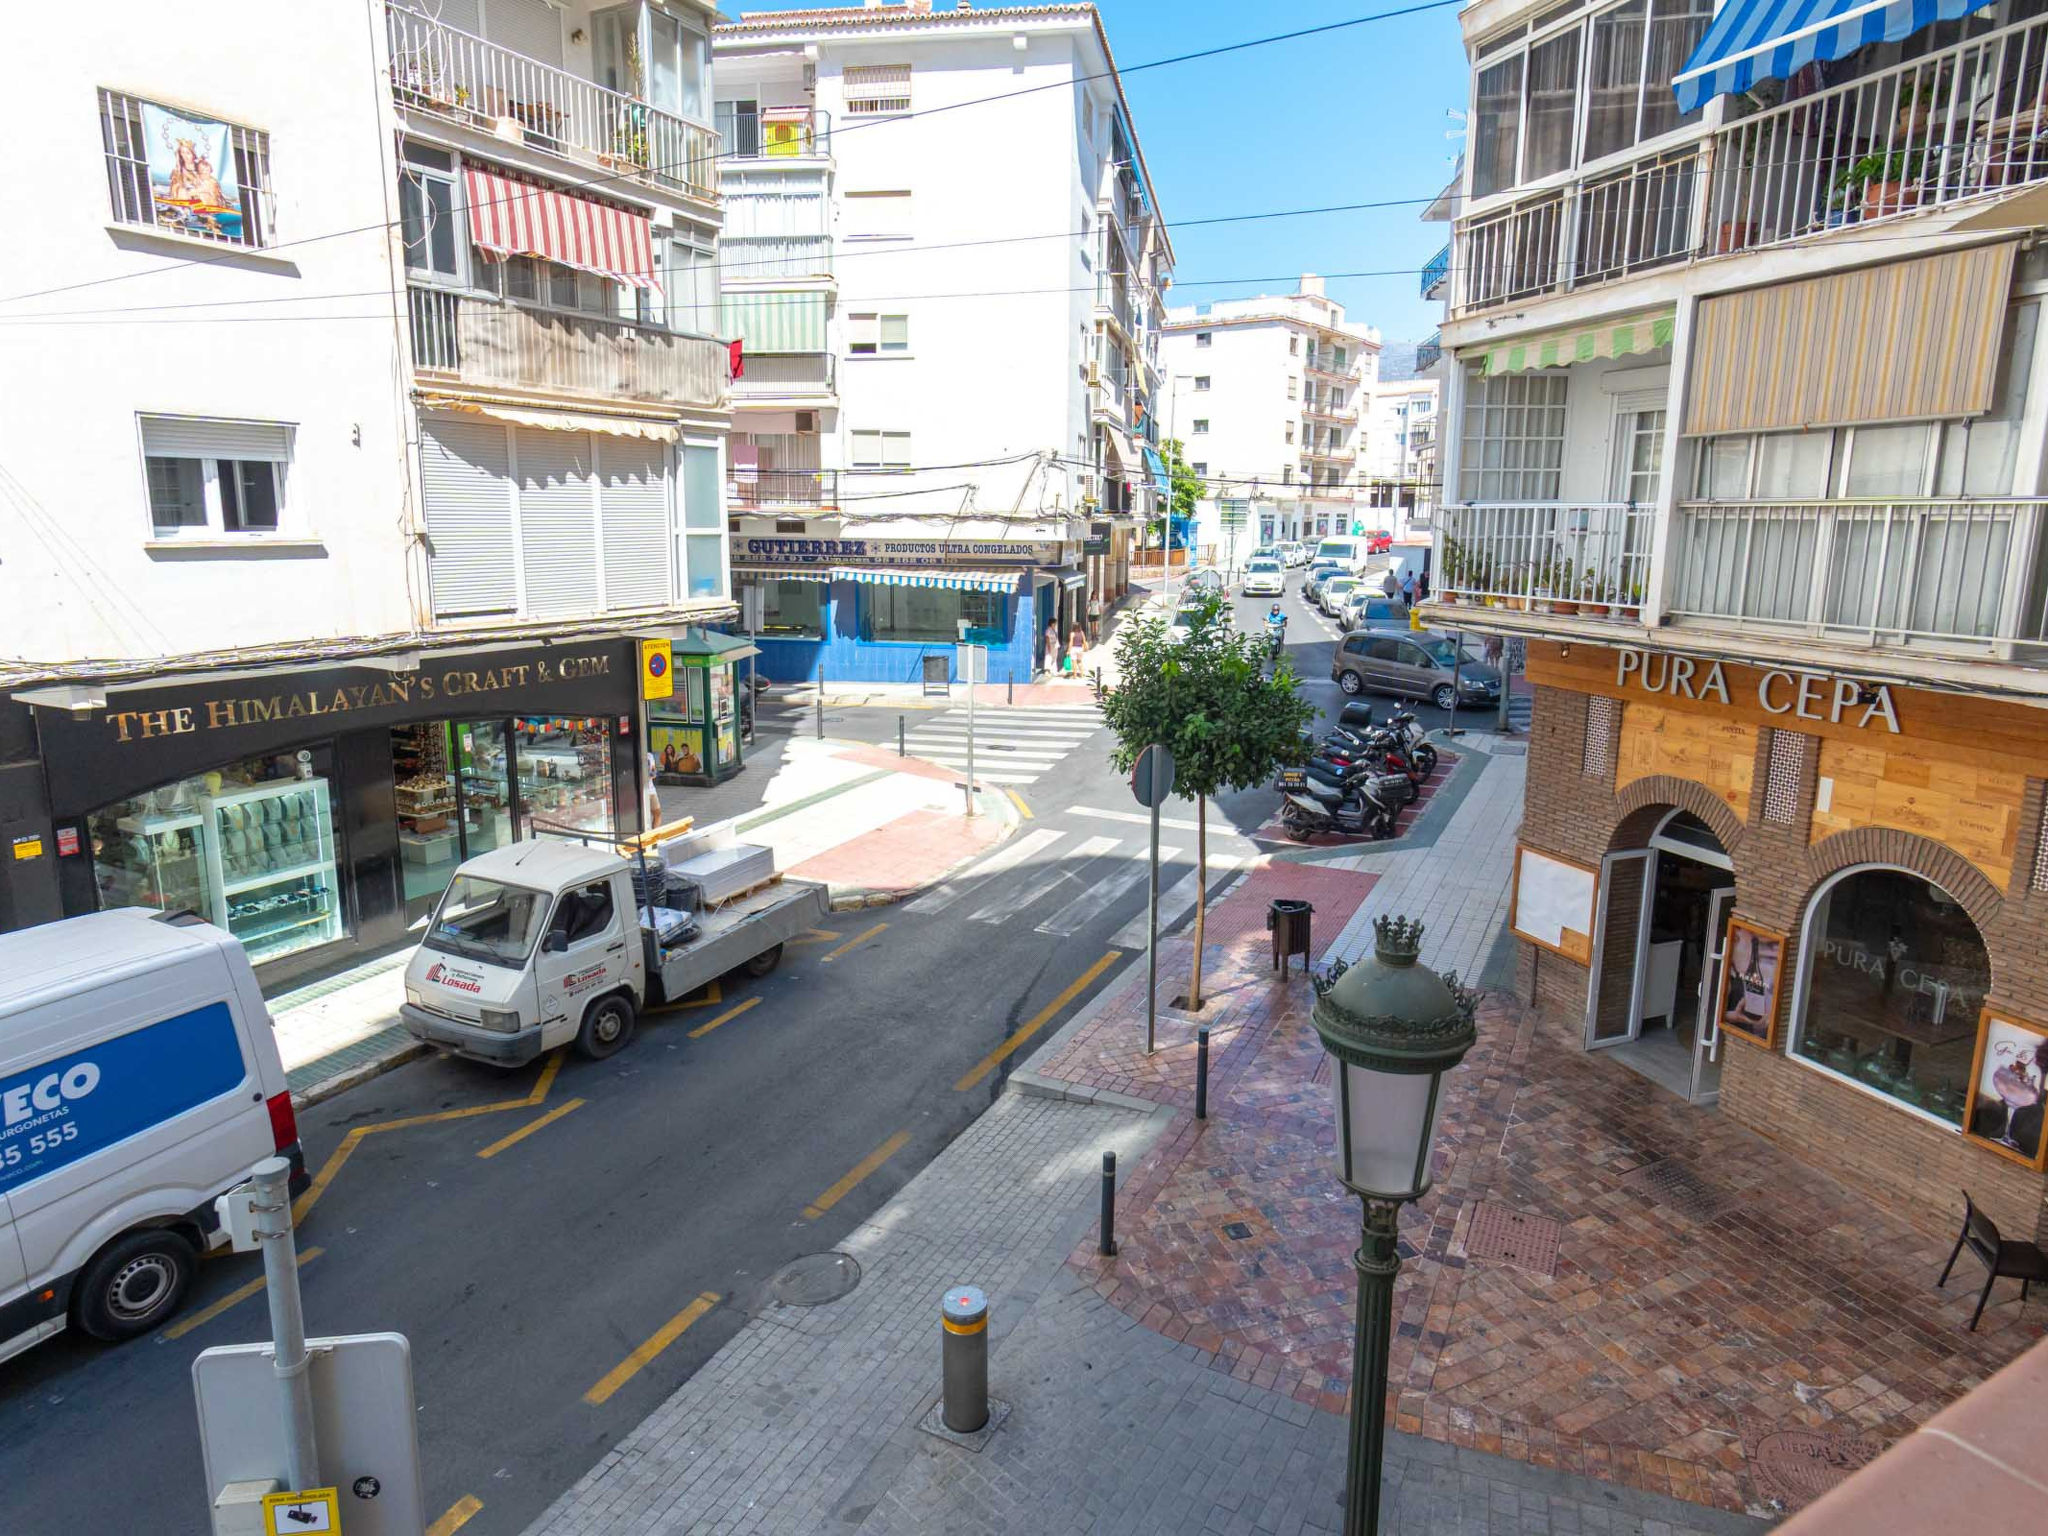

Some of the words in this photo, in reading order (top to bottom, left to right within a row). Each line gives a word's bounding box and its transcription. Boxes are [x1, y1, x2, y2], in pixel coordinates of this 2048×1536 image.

[747, 539, 868, 556] GUTIERREZ
[885, 543, 936, 553] PRODUCTOS
[939, 544, 970, 554] ULTRA
[973, 544, 1034, 555] CONGELADOS
[106, 707, 196, 743] THE
[204, 675, 435, 730] HIMALAYAN'S
[443, 664, 530, 697] CRAFT
[537, 660, 555, 685] &
[559, 654, 610, 679] GEM
[1616, 650, 1731, 705] PURA
[1758, 670, 1900, 734] CEPA
[441, 975, 481, 994] Losada
[1823, 940, 1886, 980] PURA
[1900, 967, 1970, 1009] CEPA
[0, 1062, 101, 1127] ECO
[30, 1121, 79, 1155] 555
